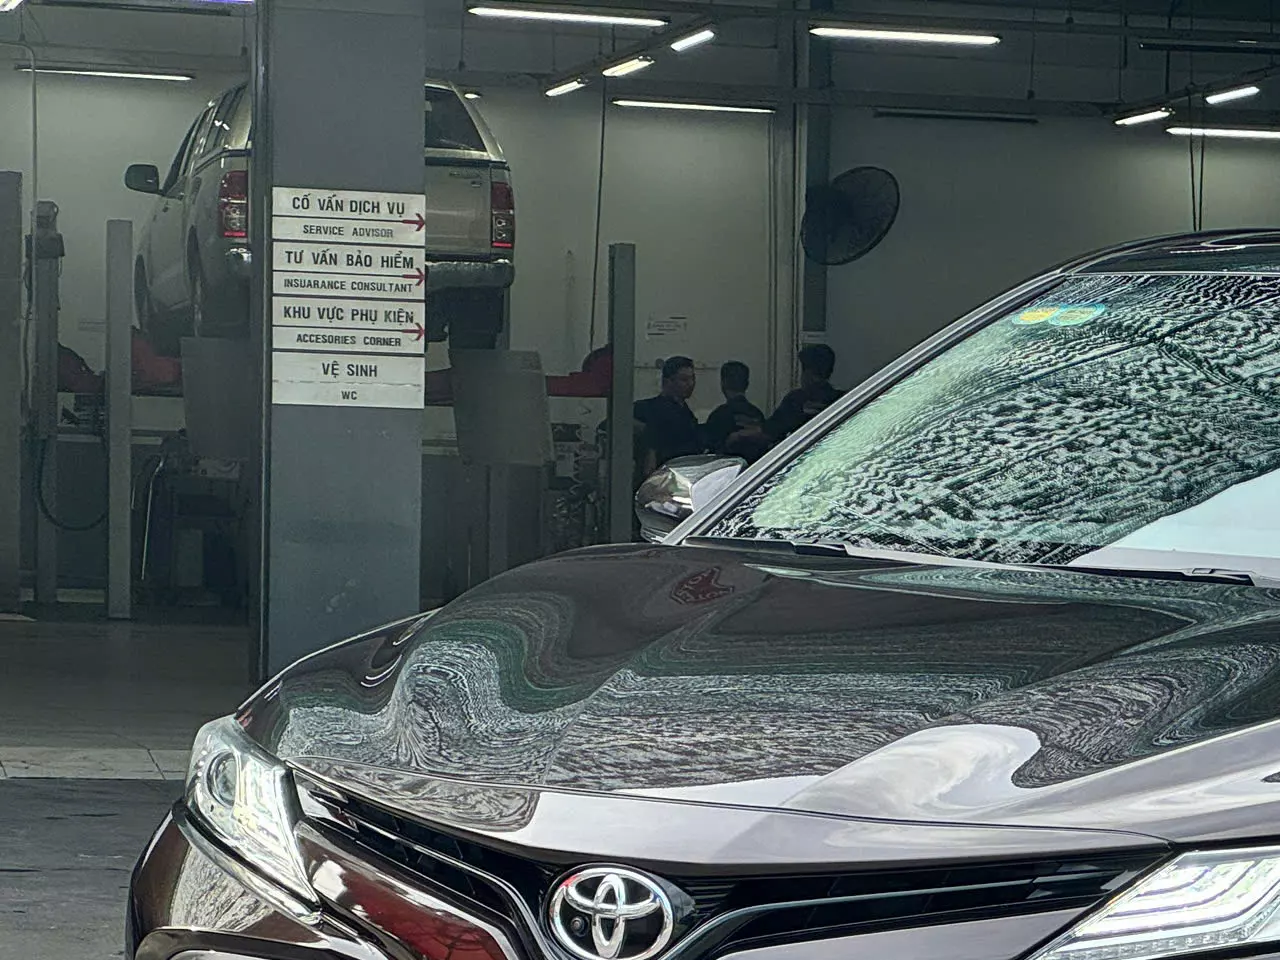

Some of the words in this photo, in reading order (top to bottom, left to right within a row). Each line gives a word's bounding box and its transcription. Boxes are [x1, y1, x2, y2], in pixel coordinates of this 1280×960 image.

[292, 193, 310, 210] CỐ
[318, 194, 344, 212] VẤN
[350, 200, 380, 216] DỊCH
[387, 202, 405, 218] VỤ
[303, 224, 345, 236] SERVICE
[352, 228, 394, 239] ADVISOR
[285, 250, 304, 264] TƯ
[312, 249, 338, 266] VẤN
[346, 250, 372, 268] BẢO
[380, 251, 414, 269] HIỂM
[283, 278, 347, 290] INSUARANCE
[350, 281, 413, 293] CONSULTANT
[283, 305, 311, 319] KHU
[317, 306, 344, 323] VỰC
[351, 308, 378, 325] PHỤ
[384, 308, 414, 324] KIỆN
[296, 333, 357, 346] ACCESORIES
[363, 336, 402, 347] CORNER
[321, 360, 340, 378] VỆ
[346, 363, 378, 378] SINH
[341, 390, 358, 401] WC
